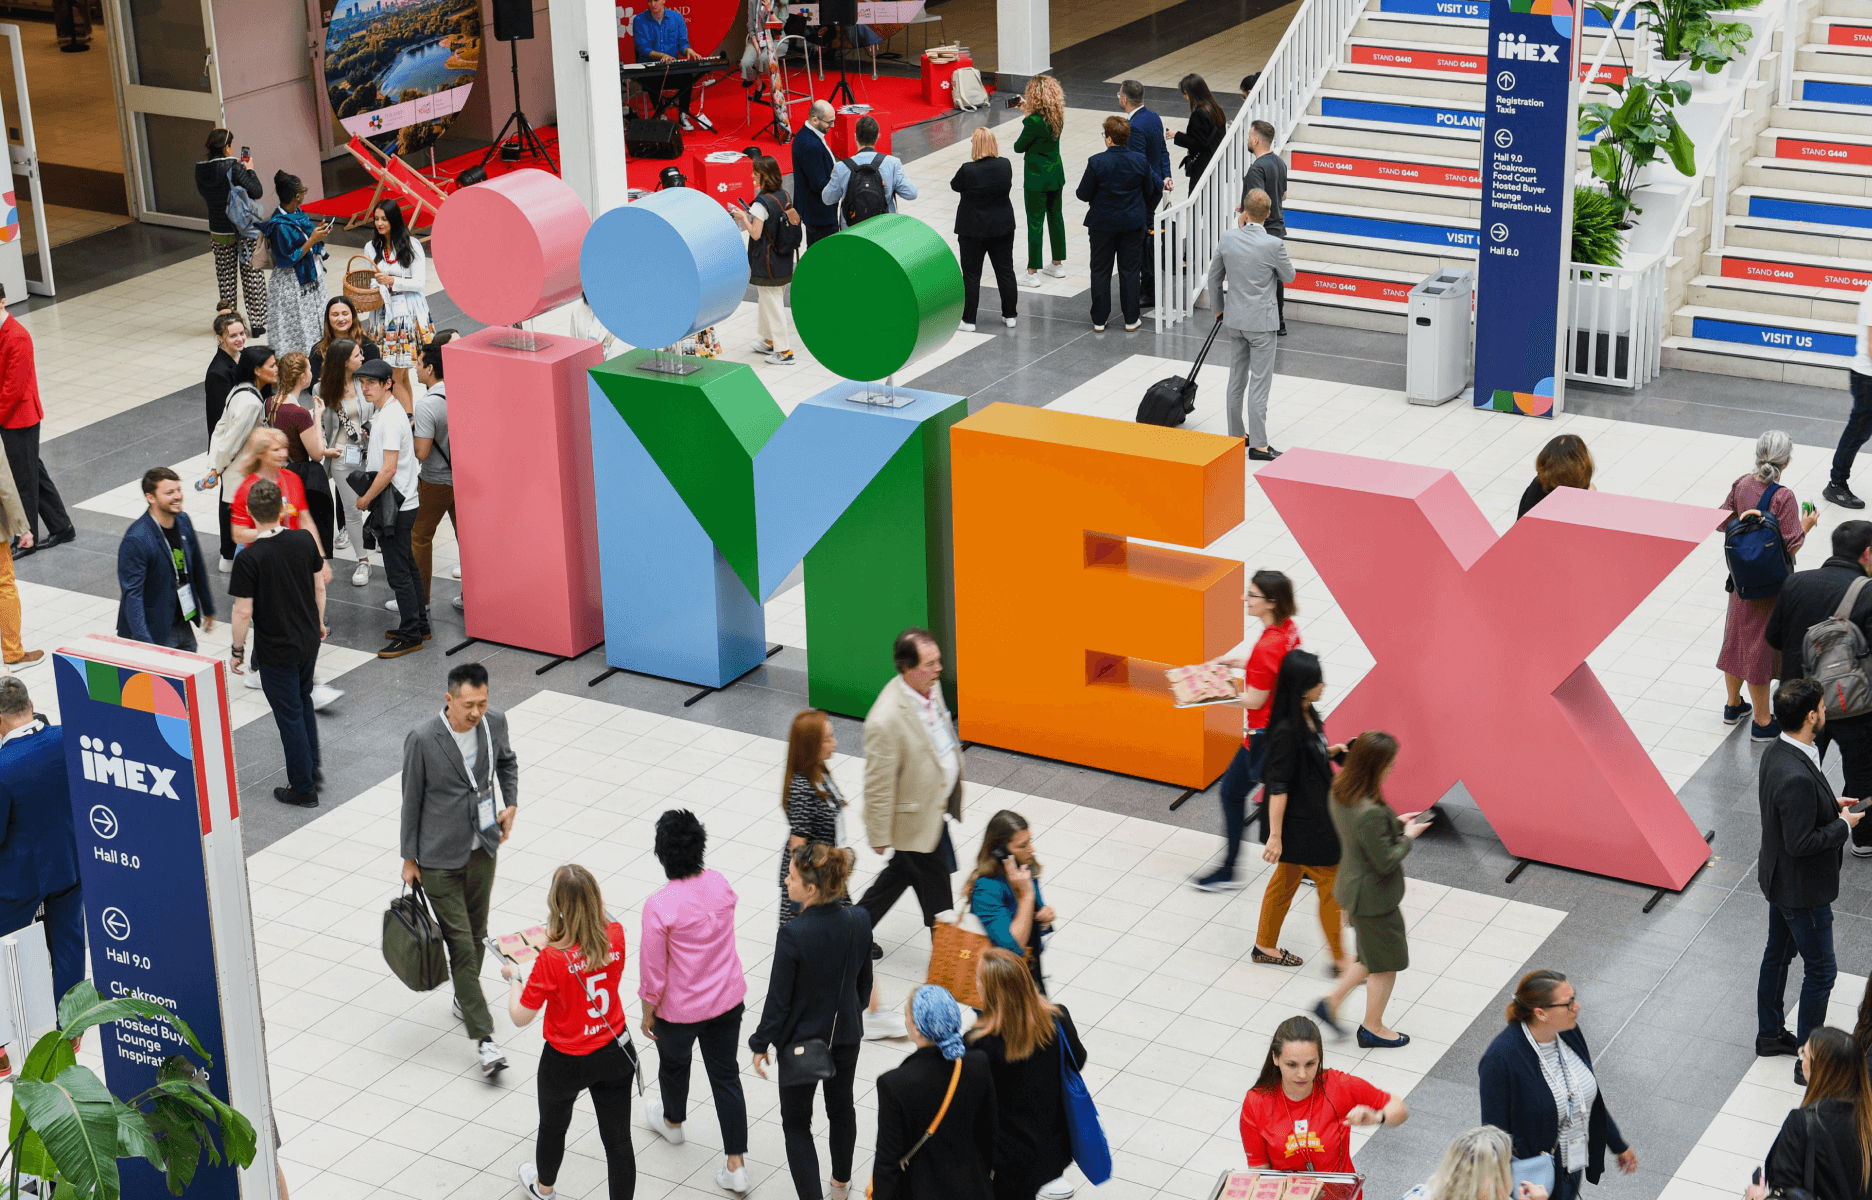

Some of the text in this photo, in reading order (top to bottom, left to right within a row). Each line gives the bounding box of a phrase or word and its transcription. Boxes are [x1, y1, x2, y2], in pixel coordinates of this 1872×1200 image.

[1437, 3, 1478, 14] VISIT US
[1373, 54, 1412, 63] STAND G440
[1496, 95, 1544, 108] Registration
[1496, 105, 1516, 114] Taxis
[1494, 152, 1522, 162] Hall 9.0
[1802, 148, 1848, 158] STAND G440
[1314, 160, 1334, 169] STAND
[1493, 162, 1536, 174] Cloakroom
[1378, 167, 1418, 178] STAND G440
[1445, 174, 1467, 182] STAND
[1493, 172, 1537, 183] Food Court
[1492, 181, 1546, 194] Hosted Buyer
[1492, 190, 1521, 202] Lounge
[1492, 200, 1552, 213] Inspiration Hub
[1446, 232, 1474, 244] VISIT
[1490, 246, 1519, 256] Hall 8.0
[1747, 268, 1794, 278] STAND G440
[1315, 280, 1356, 292] STAND G440
[1824, 276, 1850, 284] STAND
[1382, 288, 1406, 297] STAND
[1762, 332, 1812, 348] VISIT US
[94, 846, 140, 869] Hall 8.0
[106, 947, 150, 970] Hall 9.0
[110, 980, 177, 1010] Cloakroom
[586, 972, 610, 1018] 5
[115, 1018, 190, 1046] Hosted Buy
[116, 1028, 162, 1052] Lounge
[118, 1044, 166, 1066] Inspirat
